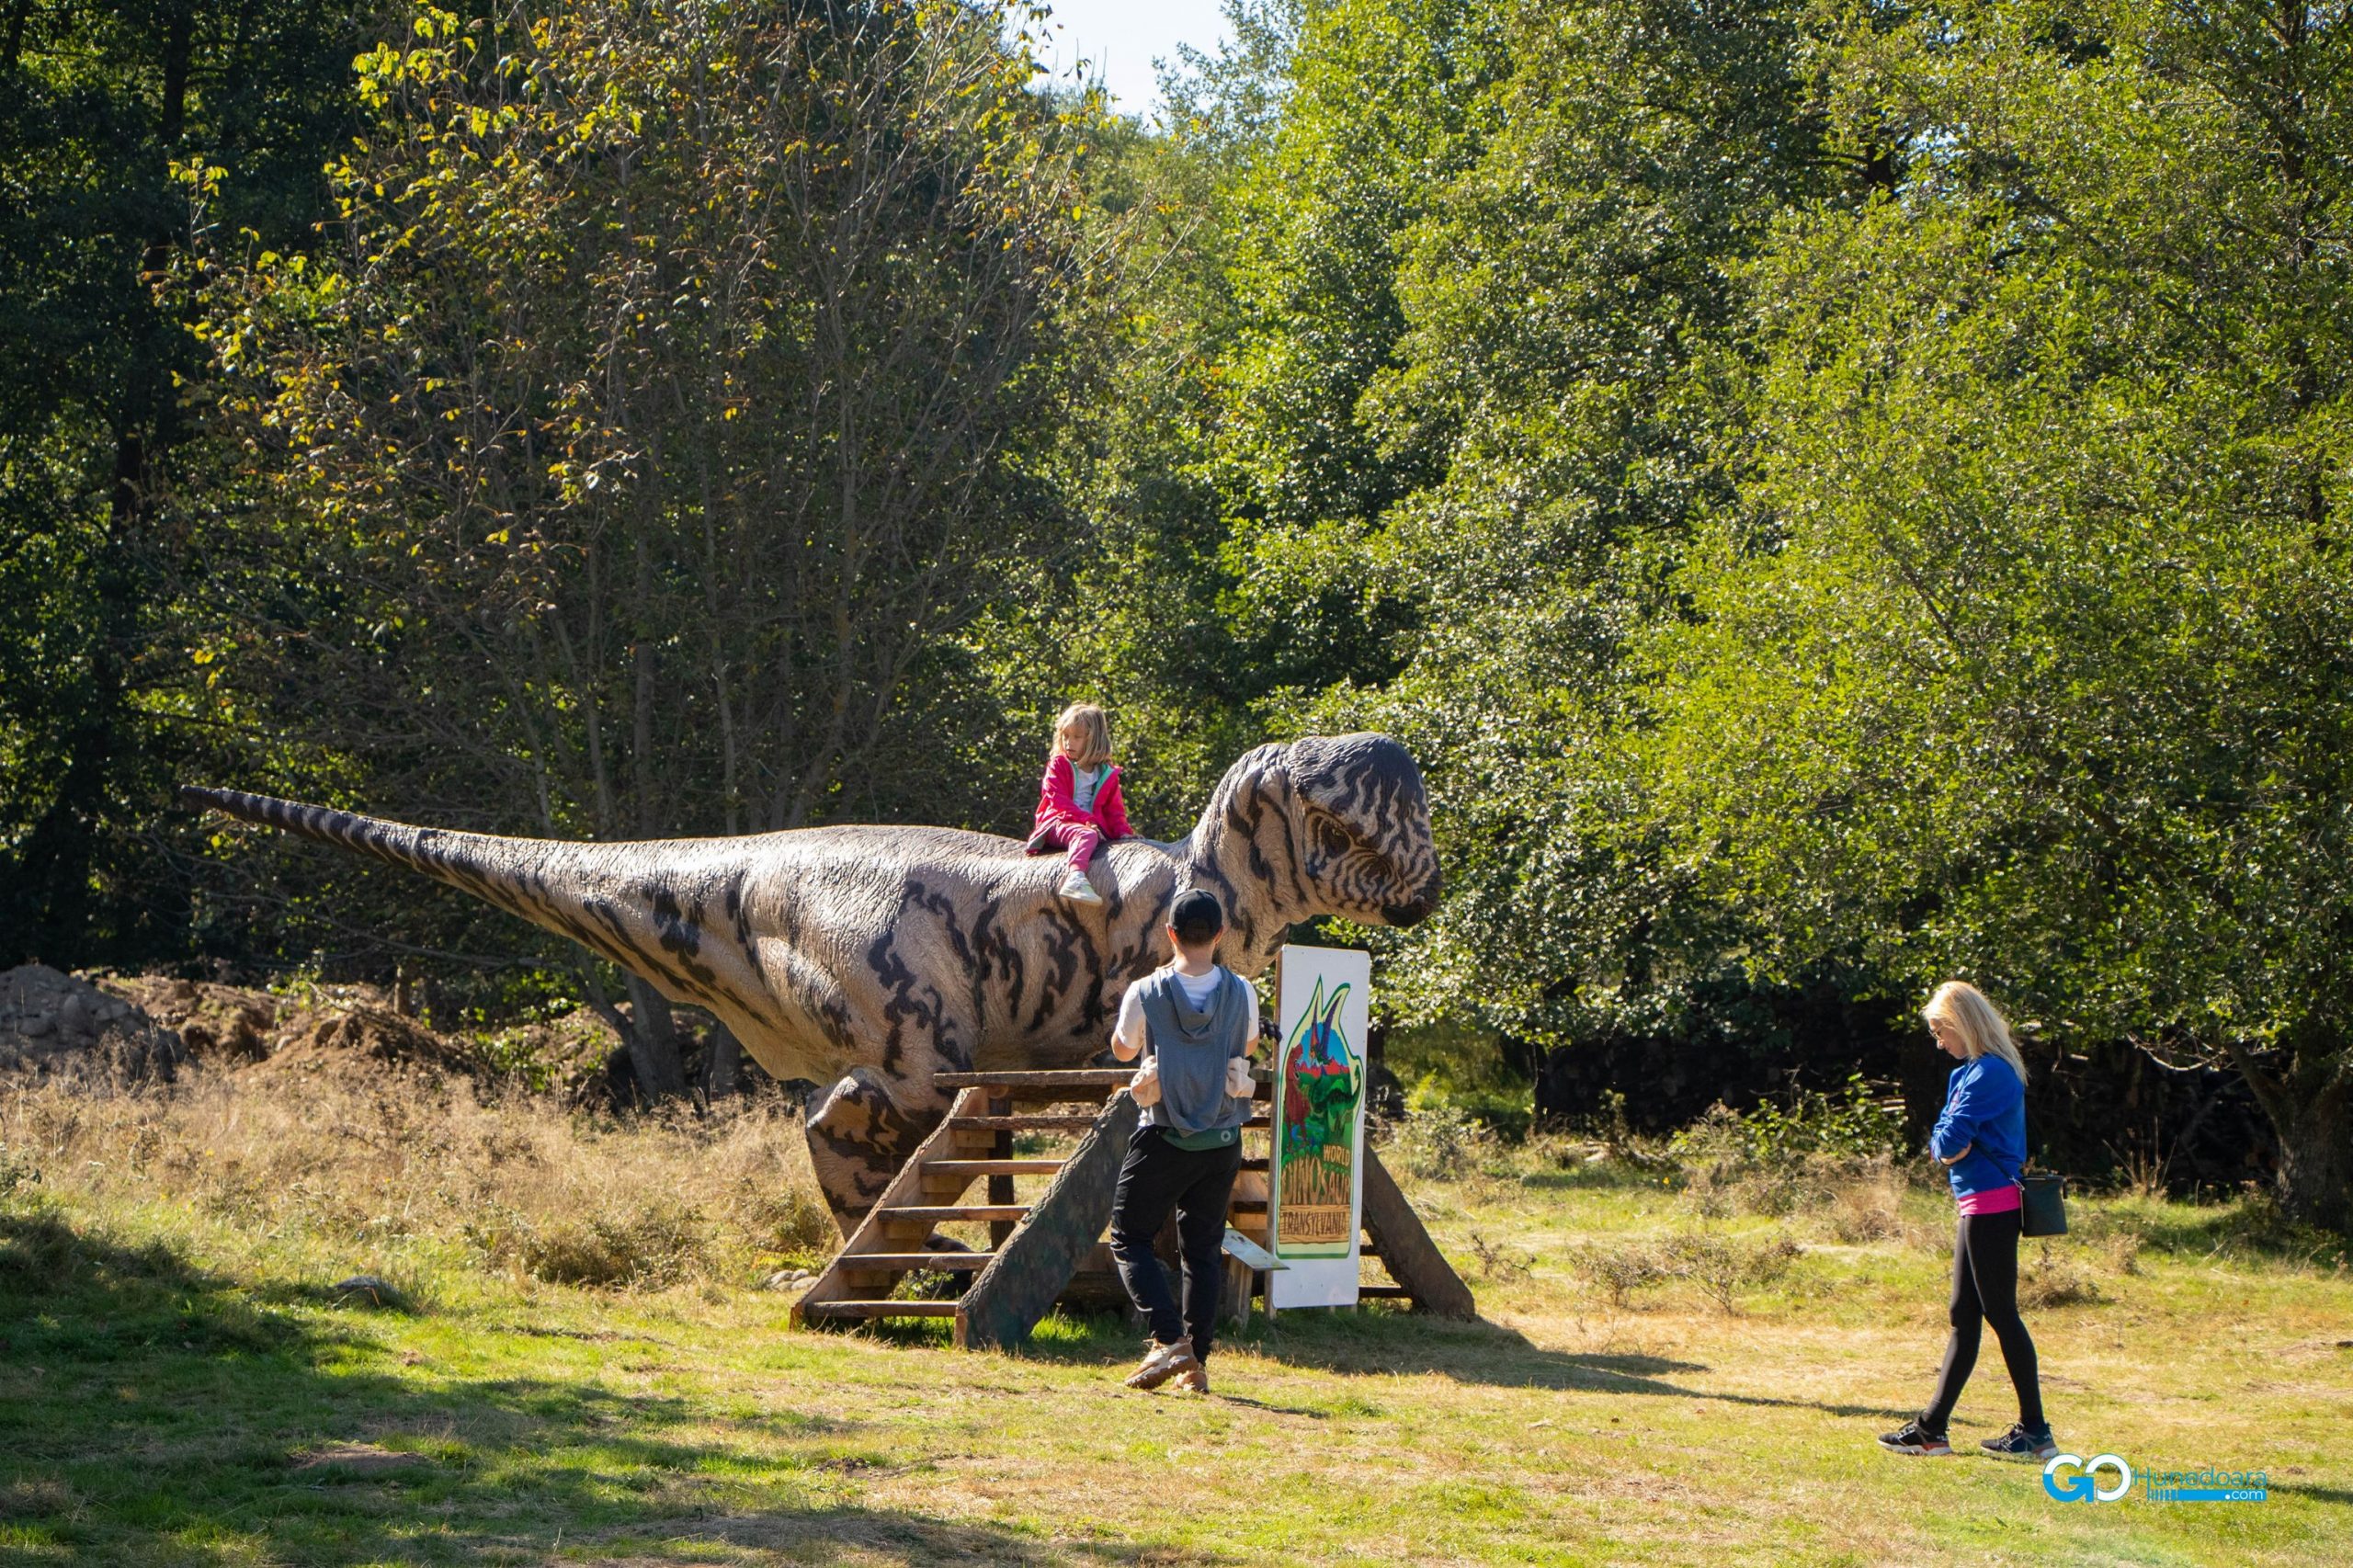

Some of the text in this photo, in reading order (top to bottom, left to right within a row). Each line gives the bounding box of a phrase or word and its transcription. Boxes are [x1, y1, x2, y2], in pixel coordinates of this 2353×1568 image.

[1324, 1144, 1350, 1165] WORLD
[1281, 1154, 1350, 1205] DINOSAUR
[1282, 1211, 1347, 1236] TRANSYLVANIA
